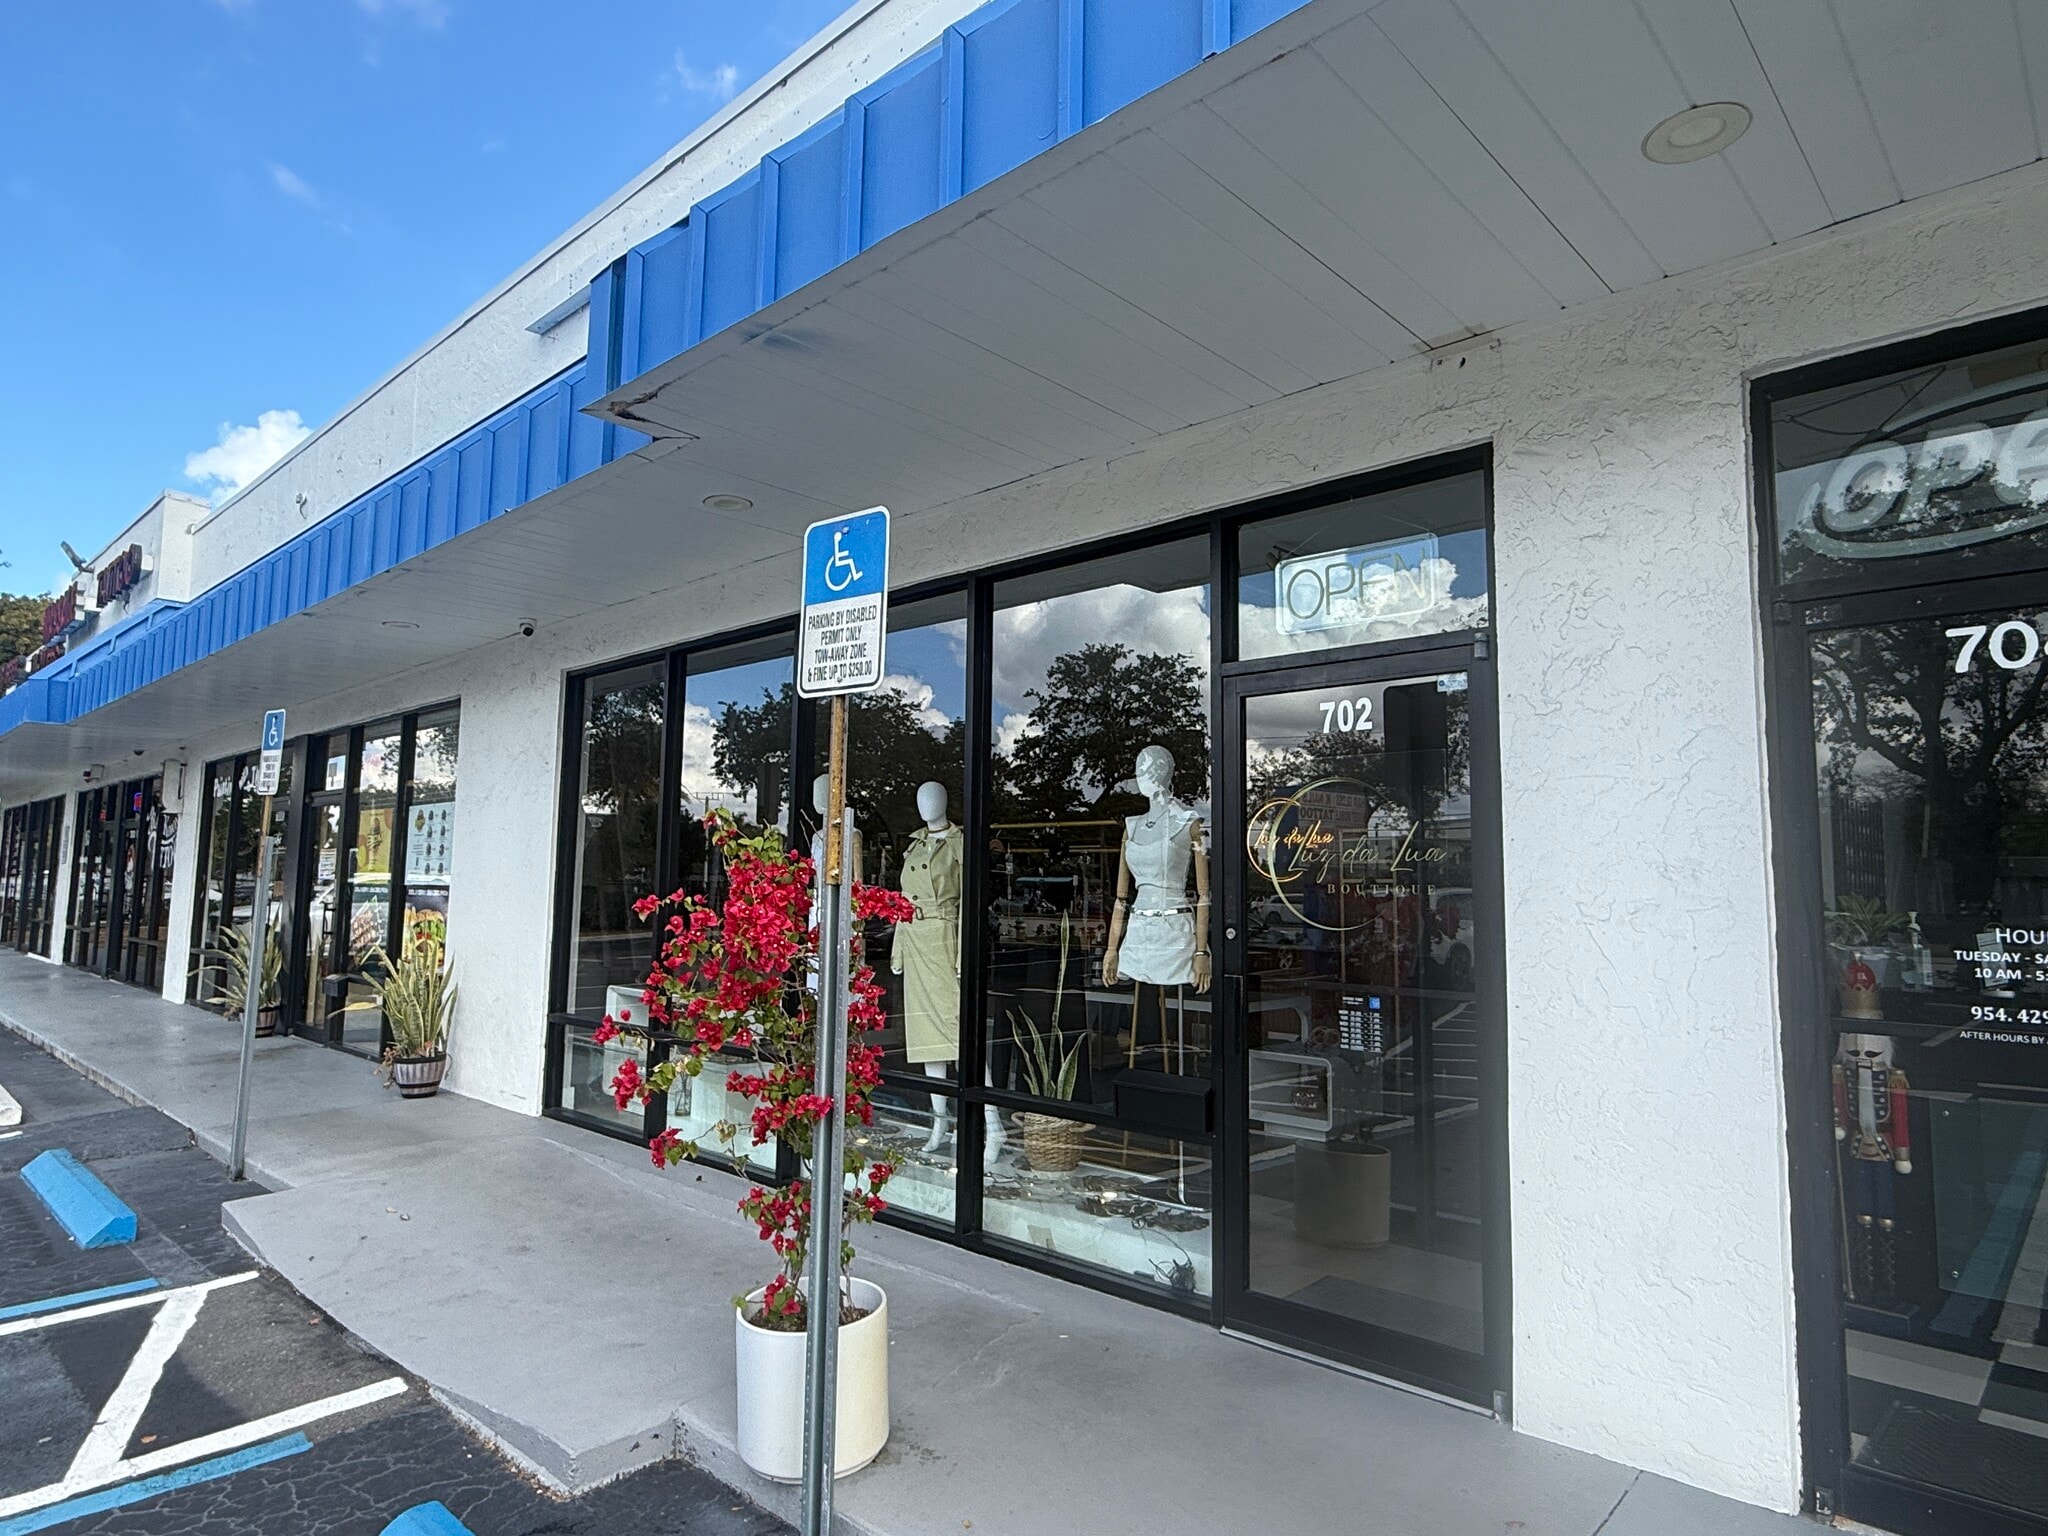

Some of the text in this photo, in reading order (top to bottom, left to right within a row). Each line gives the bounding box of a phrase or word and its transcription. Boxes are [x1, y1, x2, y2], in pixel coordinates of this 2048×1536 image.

[1286, 548, 1427, 620] OPEN
[808, 604, 877, 630] PARKING BY DISABLED
[820, 625, 862, 646] PERMIT ONLY
[814, 642, 867, 664] TOW-AWAY ZONE
[1944, 620, 2048, 674] 70
[813, 665, 827, 682] FINE
[828, 664, 838, 680] UP
[839, 663, 848, 679] TO
[848, 660, 873, 678] $250.00
[1319, 697, 1373, 734] 702
[1288, 820, 1448, 884] Luz da Lua
[1327, 884, 1437, 897] BOUTIQUE
[1996, 927, 2048, 945] HOU
[1954, 949, 2021, 963] TUESDAY
[1974, 967, 1992, 979] 10
[1995, 968, 2022, 980] AM
[1970, 1006, 2013, 1023] 954.
[1960, 1030, 2045, 1045] AFTER HOURS BY
